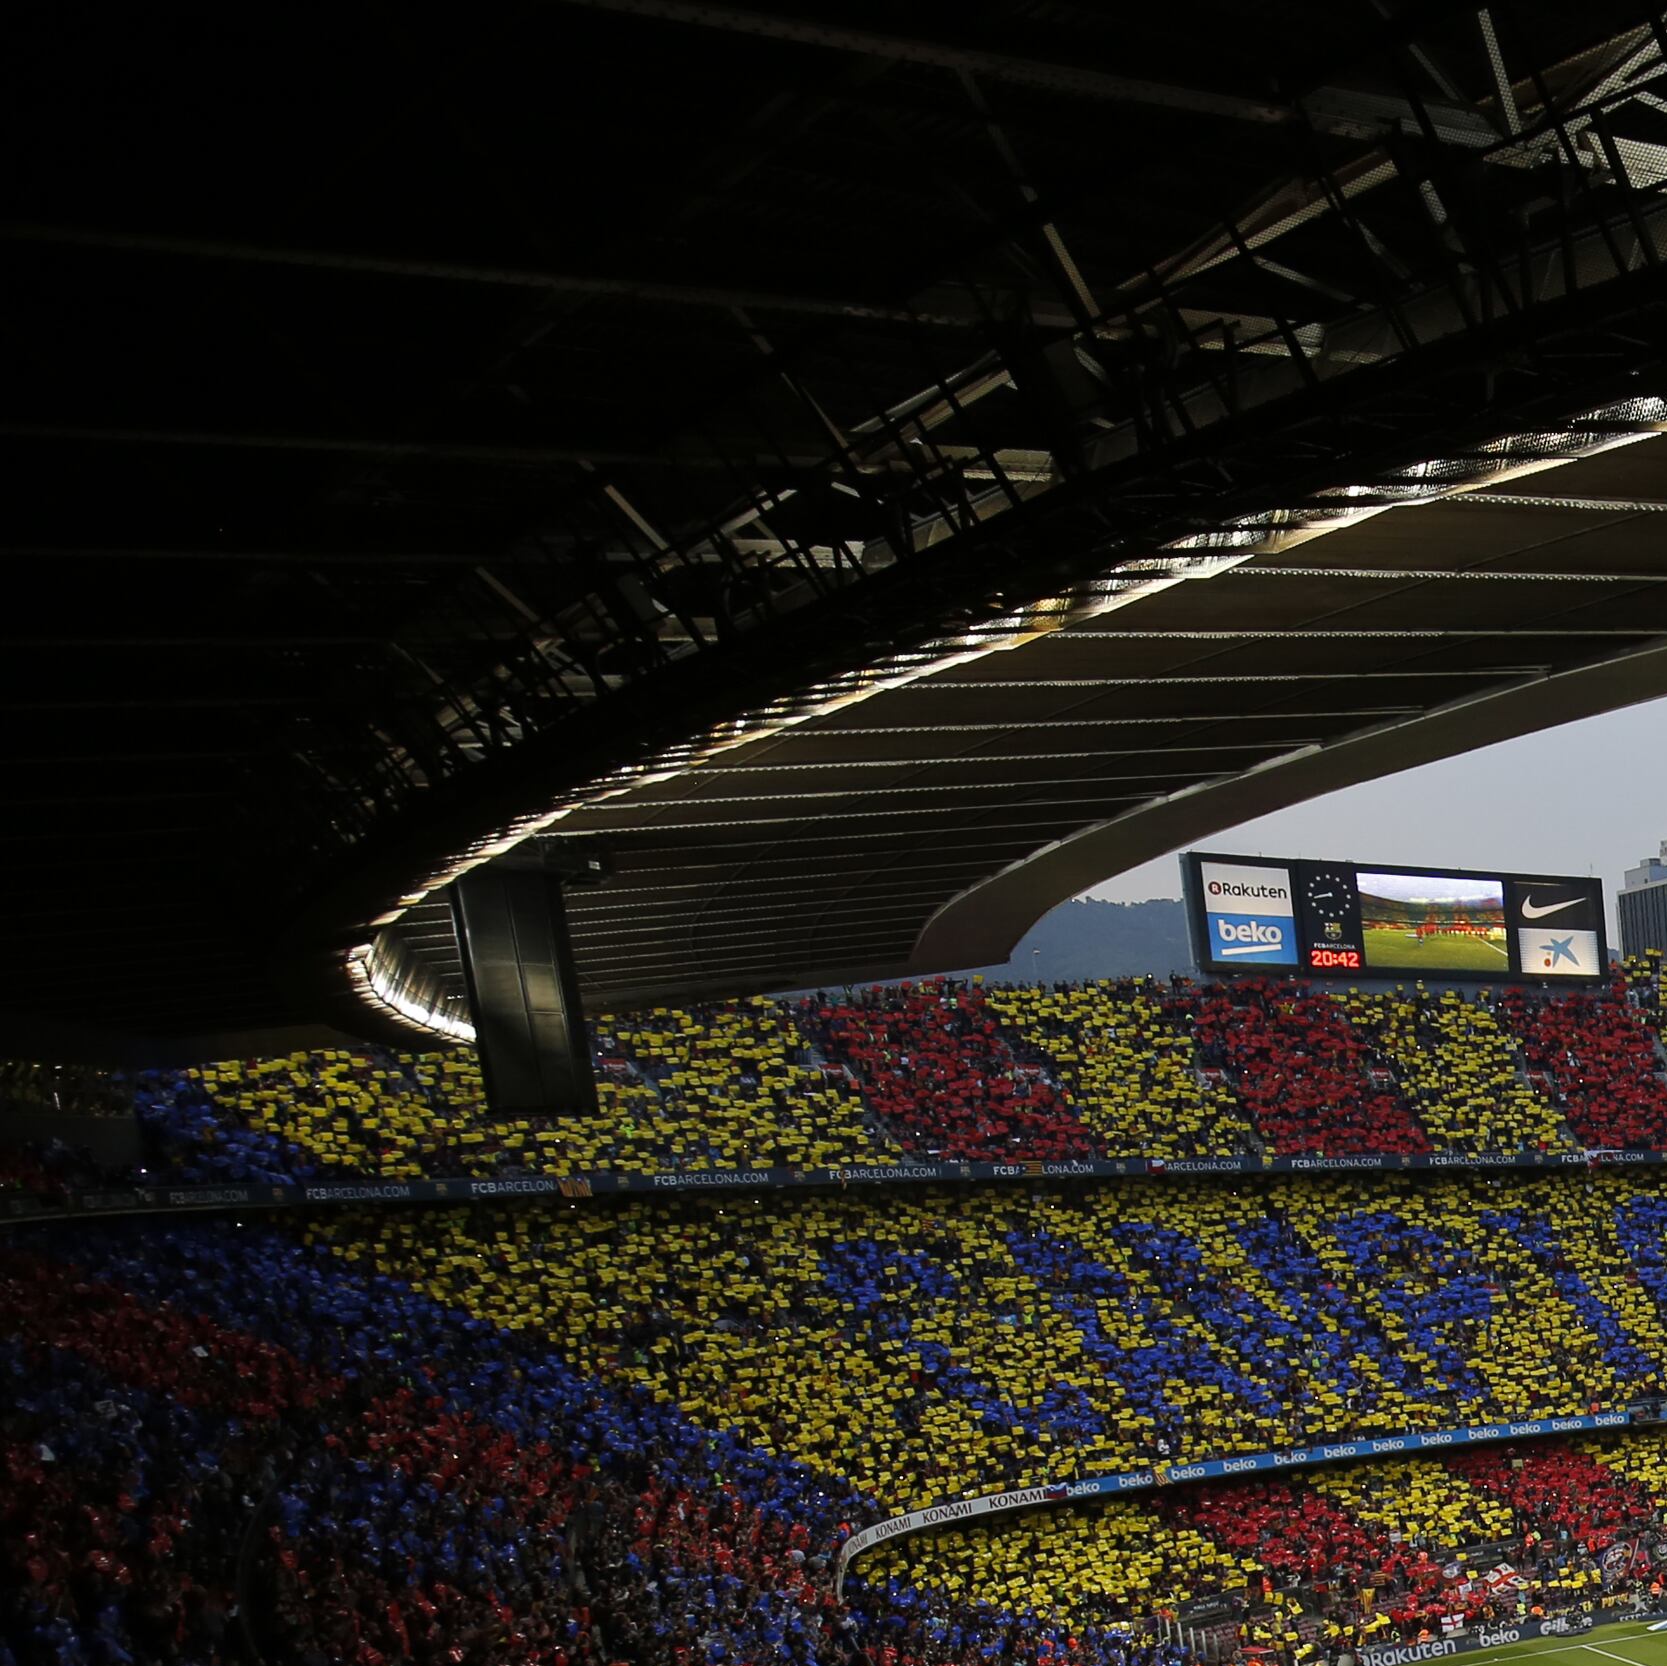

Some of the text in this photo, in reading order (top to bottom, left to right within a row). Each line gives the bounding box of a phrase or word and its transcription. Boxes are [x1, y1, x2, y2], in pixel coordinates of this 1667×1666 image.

[1222, 882, 1288, 900] Rakuten
[1217, 919, 1283, 944] beko
[1311, 950, 1360, 968] 20:42
[1290, 1154, 1382, 1169] FCBARCELONA.COM
[654, 1173, 769, 1188] FCBARCELONA.COM
[306, 1184, 411, 1201] FCBARCELONA.COM
[1552, 1419, 1583, 1433] beko
[1595, 1414, 1625, 1428] beko
[1468, 1428, 1500, 1443] beko
[1510, 1424, 1542, 1438] beko
[1372, 1439, 1405, 1454] beko
[1420, 1434, 1453, 1448] beko
[1323, 1446, 1357, 1460] beko
[1170, 1465, 1206, 1481] beko
[1223, 1459, 1257, 1474] beko
[1119, 1473, 1154, 1490] beko
[988, 1490, 1046, 1509] KONAMI
[923, 1502, 975, 1524] KONAMI
[876, 1516, 912, 1539] KONAMI
[1479, 1627, 1521, 1649] beko
